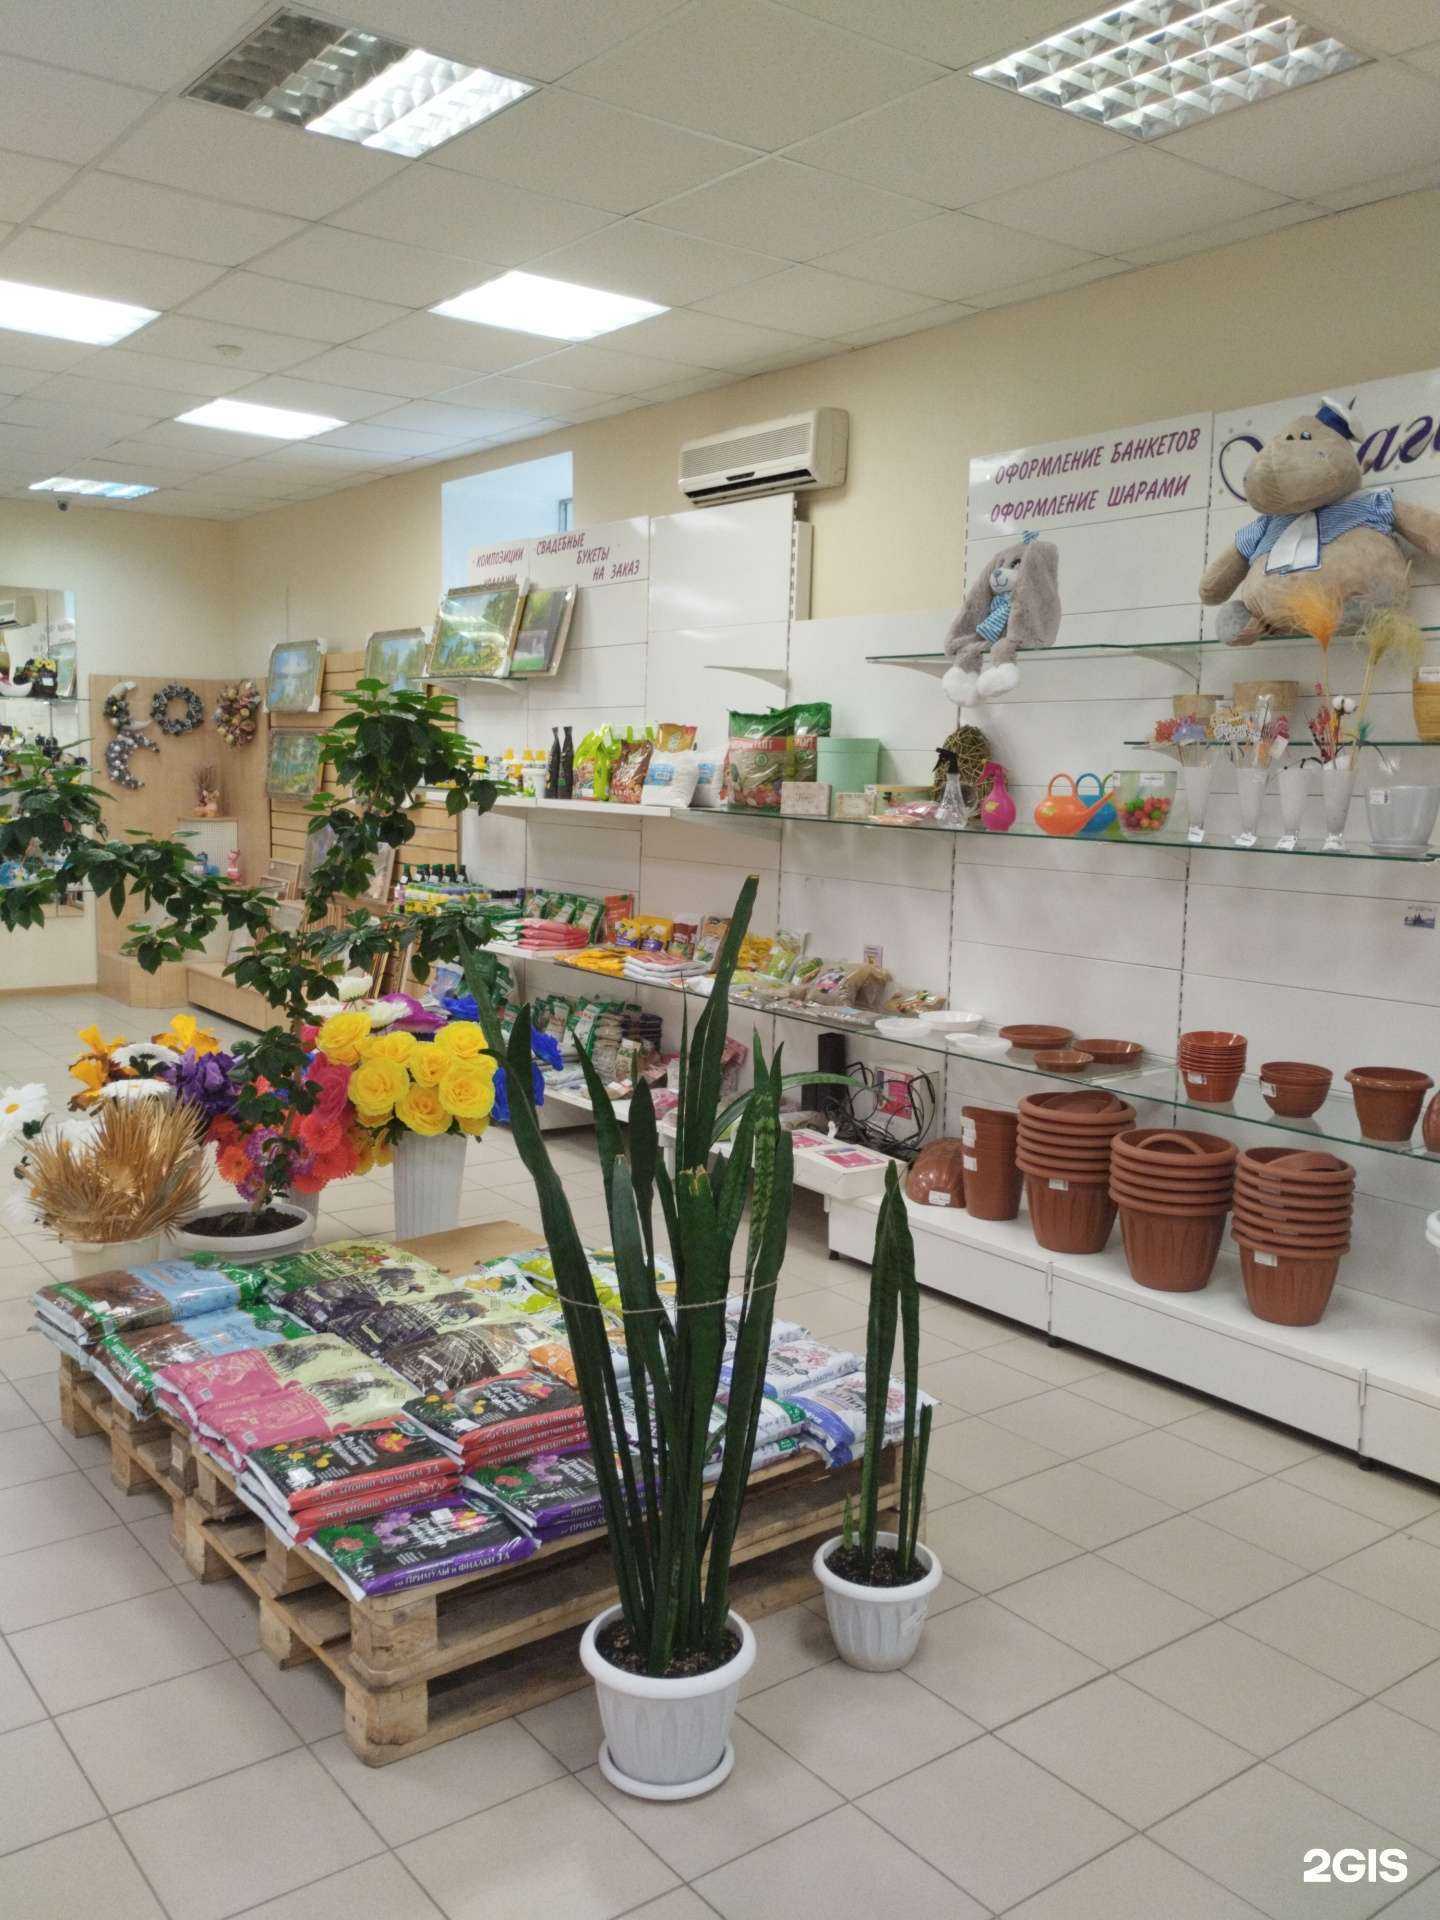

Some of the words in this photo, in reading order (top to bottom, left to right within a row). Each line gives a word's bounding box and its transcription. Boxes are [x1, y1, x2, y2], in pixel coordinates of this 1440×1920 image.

[995, 446, 1105, 485] ОФОРМЛЕНИЕ
[1110, 428, 1201, 464] БАНКЕТОВ
[990, 489, 1099, 523] ОФОРМЛЕНИЕ
[1107, 474, 1191, 507] ШАРАМИ
[536, 532, 586, 556] СВАДЕБНЫЕ
[476, 546, 525, 569] КОМПОЗИЦИИ
[576, 548, 610, 565] БУКЕТЫ
[592, 568, 606, 581] НА
[610, 559, 641, 579] ЗАКАЗ
